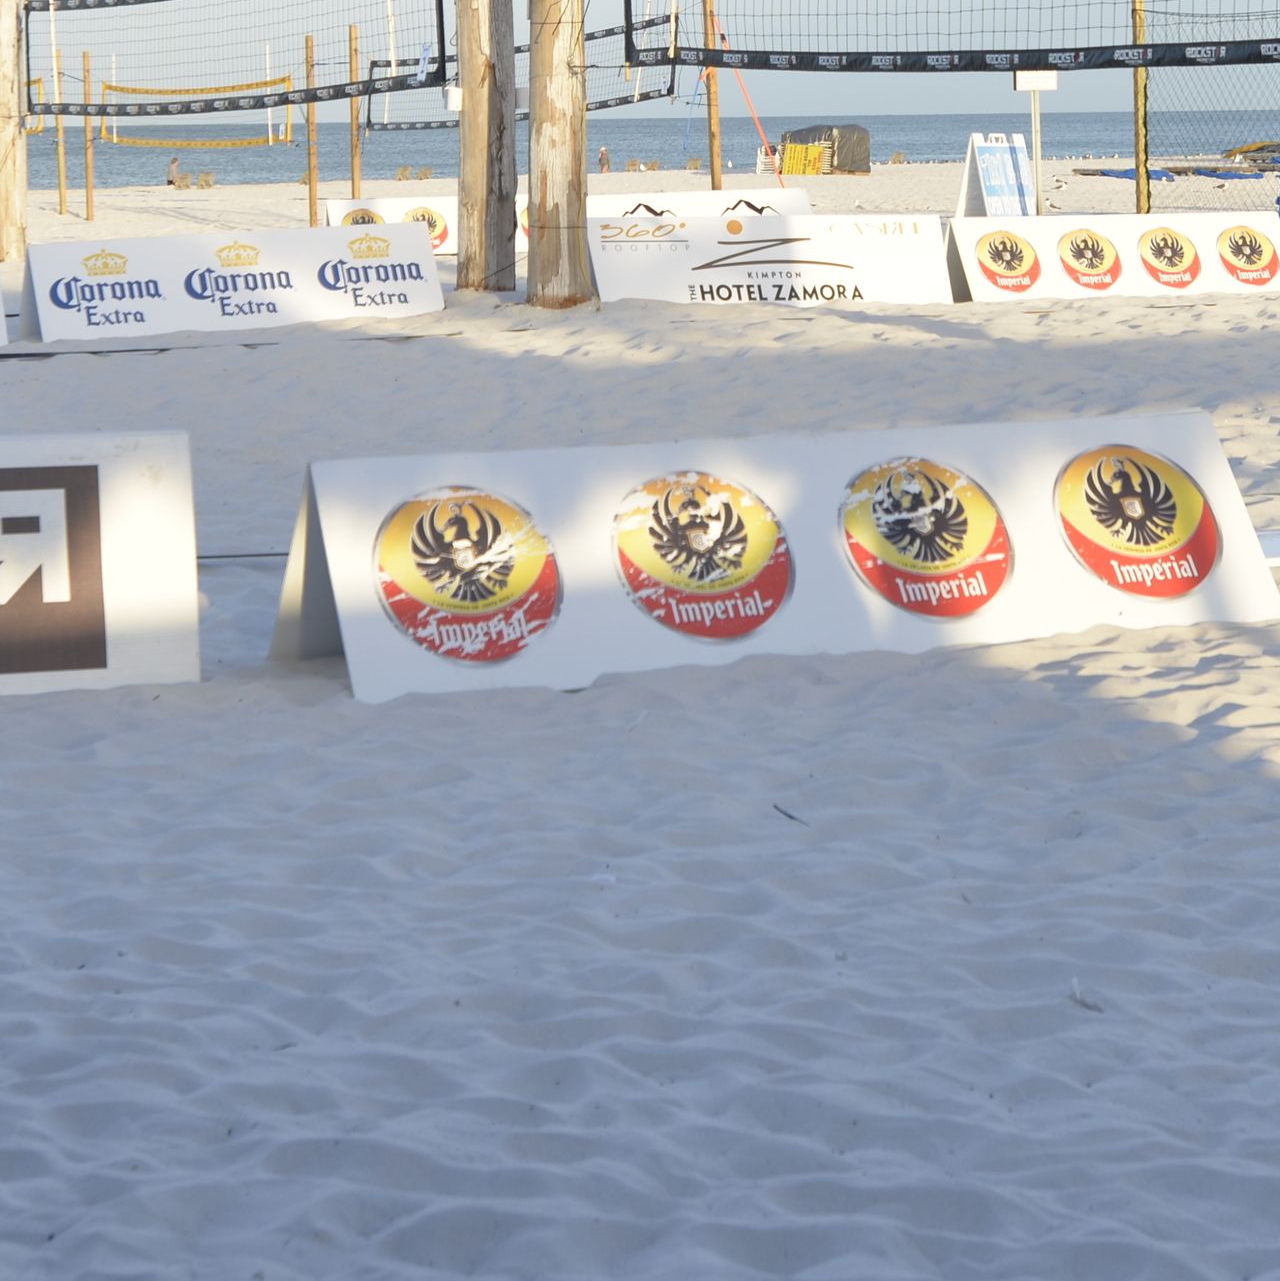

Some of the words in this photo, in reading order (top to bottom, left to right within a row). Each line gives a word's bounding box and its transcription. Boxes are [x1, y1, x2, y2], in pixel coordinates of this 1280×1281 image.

[601, 244, 690, 252] ROOFTOP
[183, 267, 293, 303] Corona
[317, 258, 425, 294] Corona
[747, 271, 802, 279] KIMPTON
[996, 274, 1031, 288] Imperial
[1078, 272, 1112, 286] Imperial
[1158, 270, 1192, 284] Imperial
[1237, 268, 1271, 281] Imperial
[49, 275, 162, 312] Corona
[353, 287, 409, 308] Extra
[688, 284, 696, 301] THE
[700, 284, 768, 301] HOTEL
[773, 284, 864, 301] ZAMORA
[86, 305, 146, 327] Extra
[220, 296, 278, 317] Extra
[1110, 554, 1200, 587] Imperial
[895, 571, 988, 606] Imperial
[669, 591, 765, 627] Imperial
